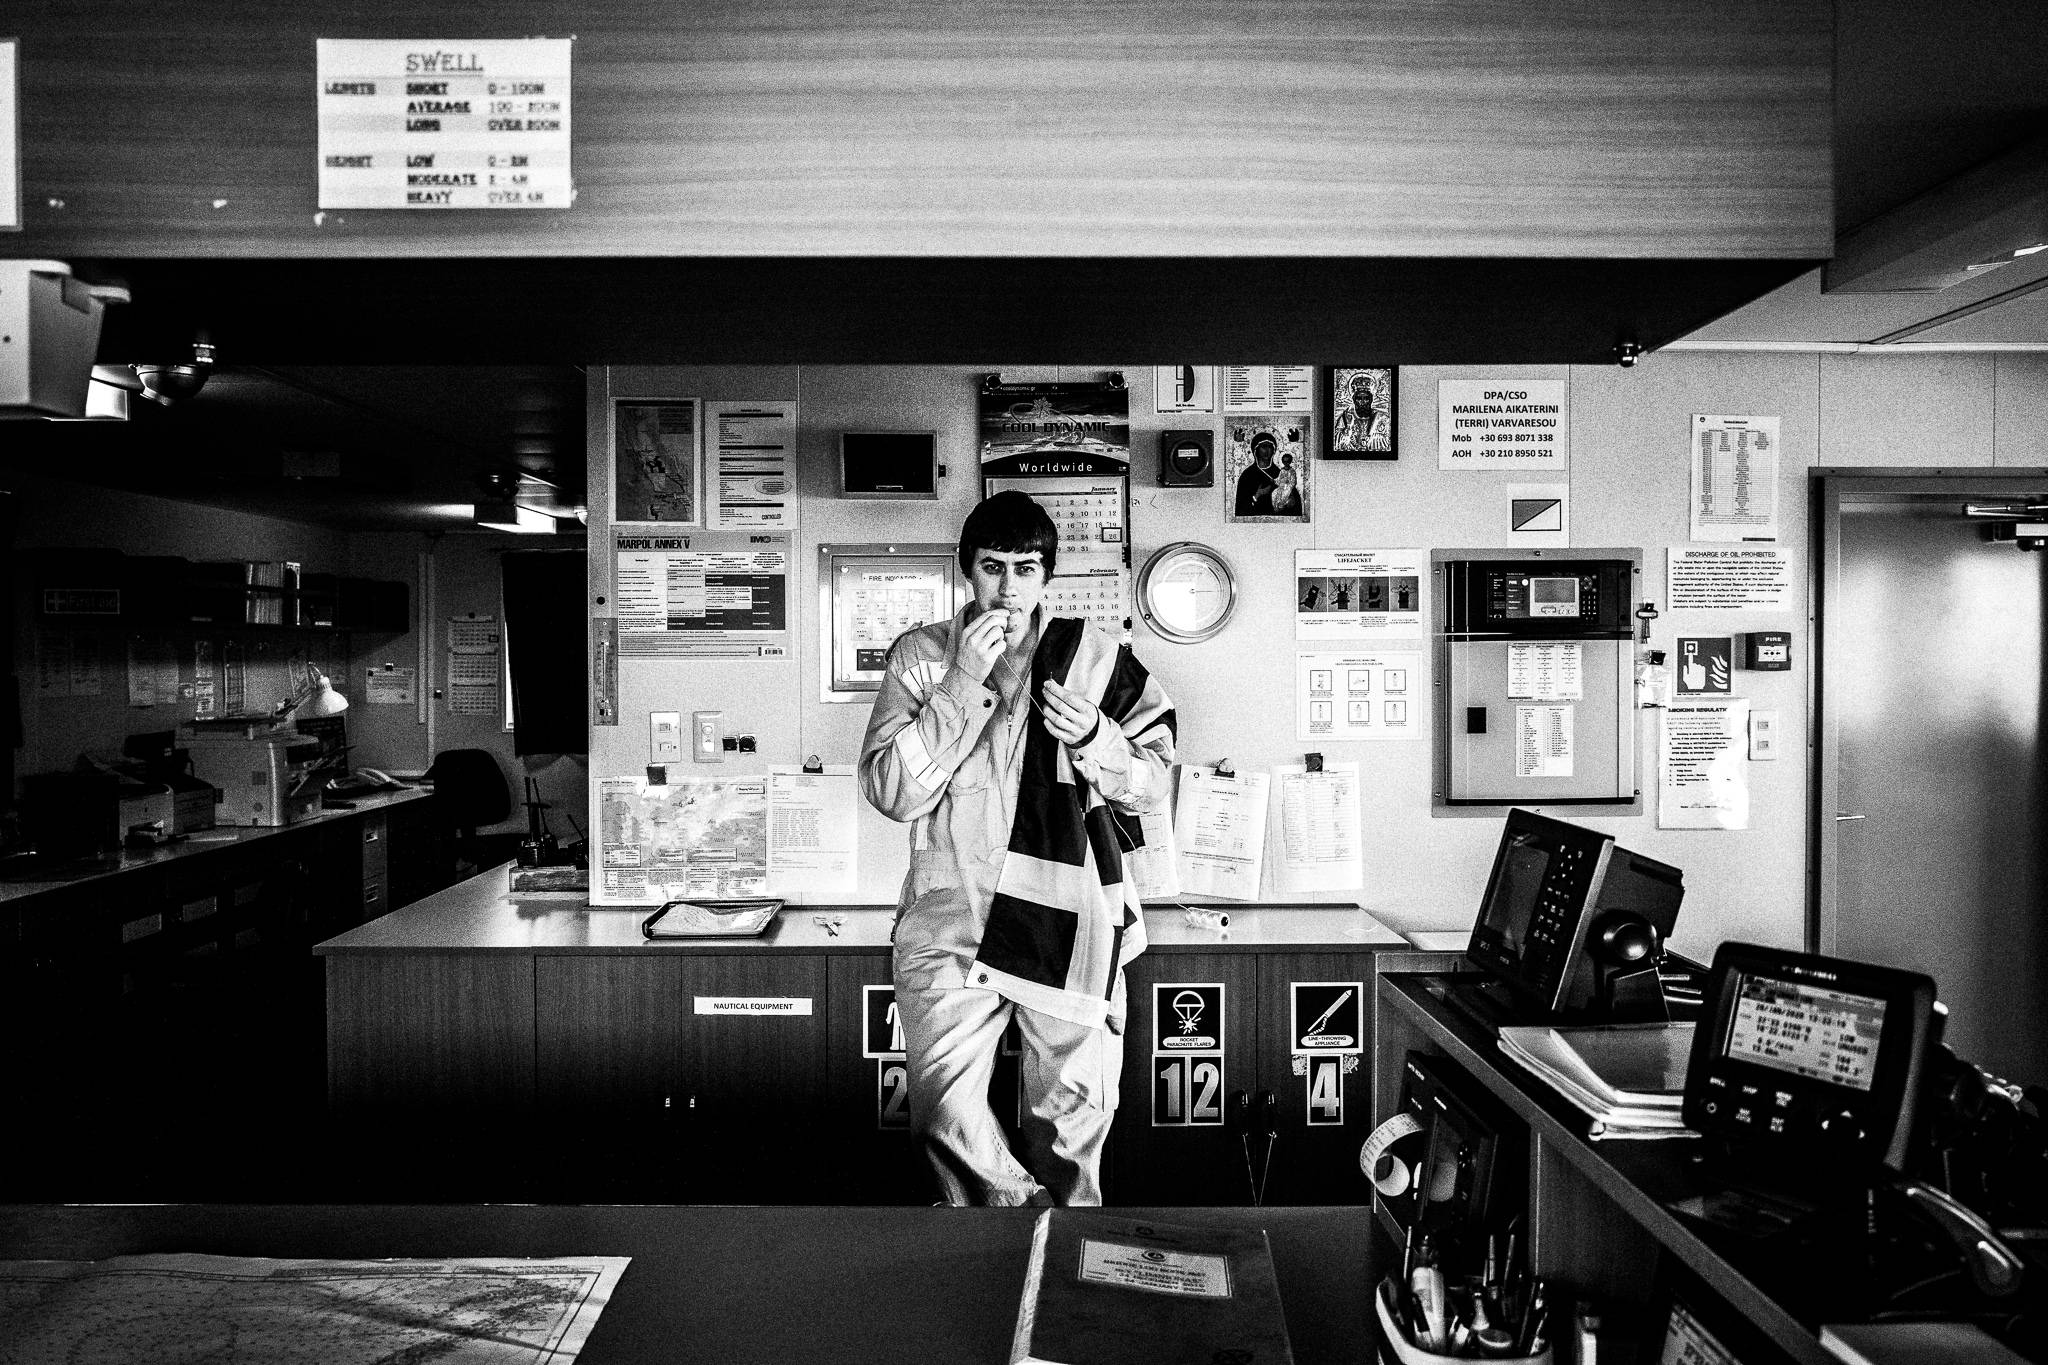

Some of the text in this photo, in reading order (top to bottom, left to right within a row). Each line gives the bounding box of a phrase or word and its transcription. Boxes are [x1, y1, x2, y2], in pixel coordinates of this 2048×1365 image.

[406, 51, 484, 71] SWELL
[407, 102, 471, 114] AVERAGE
[406, 119, 441, 132] LONG
[488, 119, 522, 131] OVER
[406, 154, 435, 168] LOW
[407, 174, 478, 186] MODERATE
[407, 192, 453, 204] HEAVY
[489, 192, 522, 203] OVER
[1484, 390, 1527, 401] DPA/CSO
[1452, 405, 1559, 413] MARILENA AIKATERINI
[1002, 422, 1110, 433] COOL DYNAMIC
[1455, 418, 1557, 429] (TERRI) VARVARESOU
[1452, 434, 1553, 442] Mob +30 693 8071 338
[1452, 450, 1553, 458] AOH +30 210 8950 521
[1019, 462, 1093, 472] Worldwide
[617, 539, 652, 549] MARPOL
[655, 539, 683, 549] ANNEX
[683, 539, 690, 549] V
[884, 1066, 908, 1121] 2
[1160, 1062, 1219, 1117] 12
[1311, 1062, 1340, 1117] 4
